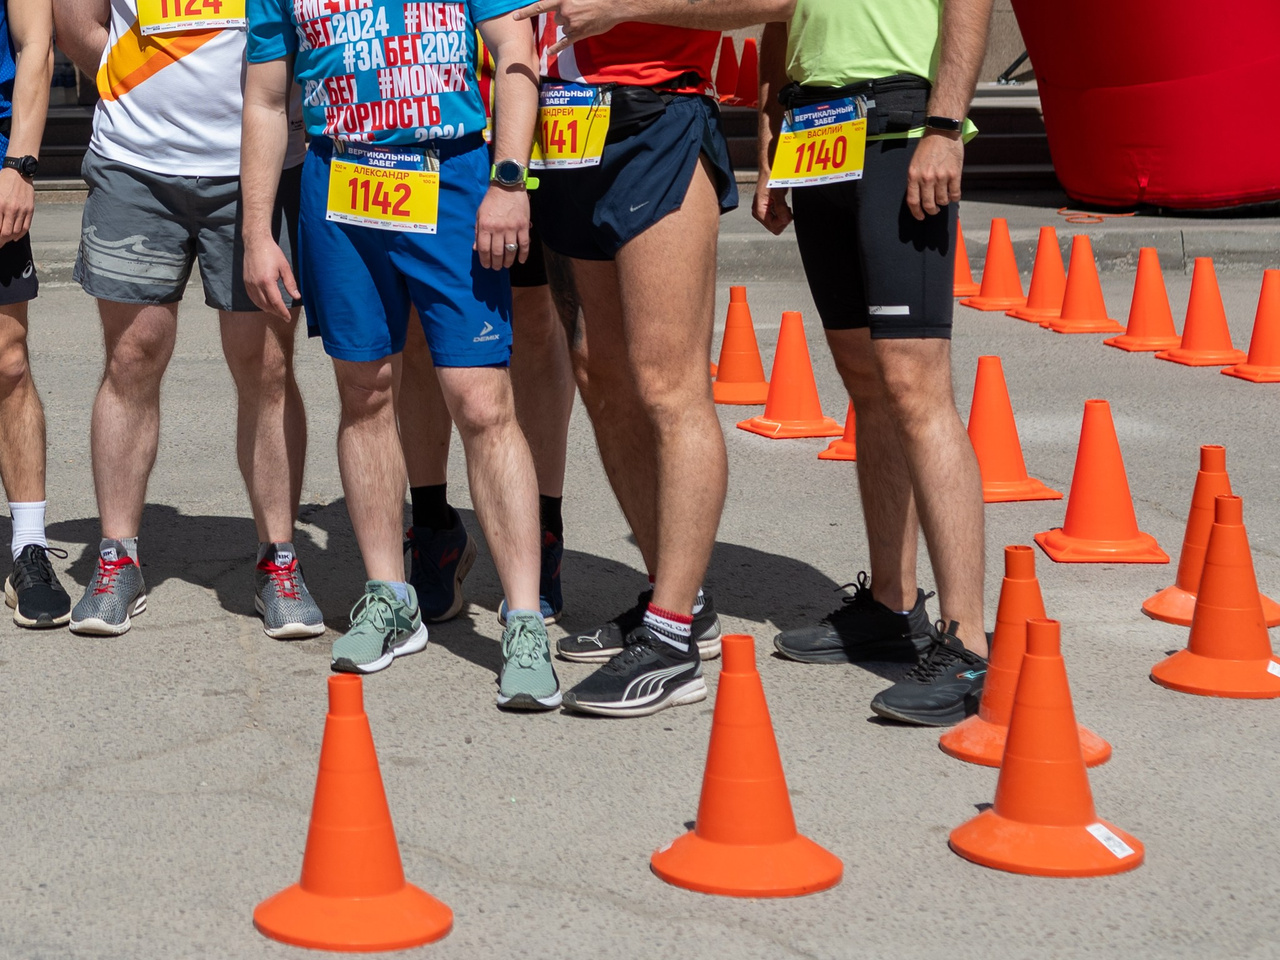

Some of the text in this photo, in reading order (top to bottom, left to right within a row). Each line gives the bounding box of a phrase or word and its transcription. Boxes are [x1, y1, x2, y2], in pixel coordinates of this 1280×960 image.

[404, 3, 466, 33] #ЦЕЛЬ
[343, 32, 467, 73] #ЗАБЕГ2024
[794, 105, 854, 122] ВЕРТИКАЛЬНЫЙ
[813, 116, 836, 126] ЗАБЕГ
[807, 124, 843, 139] ВАСИЛИЙ
[347, 147, 421, 162] ВЕРТИКАЛЬНЫЙ
[794, 135, 847, 174] 1140
[368, 158, 397, 167] ЗАБЕГ
[353, 166, 410, 181] АЛЕКСАНДР
[348, 177, 412, 217] 1142
[472, 334, 500, 343] DEMIX
